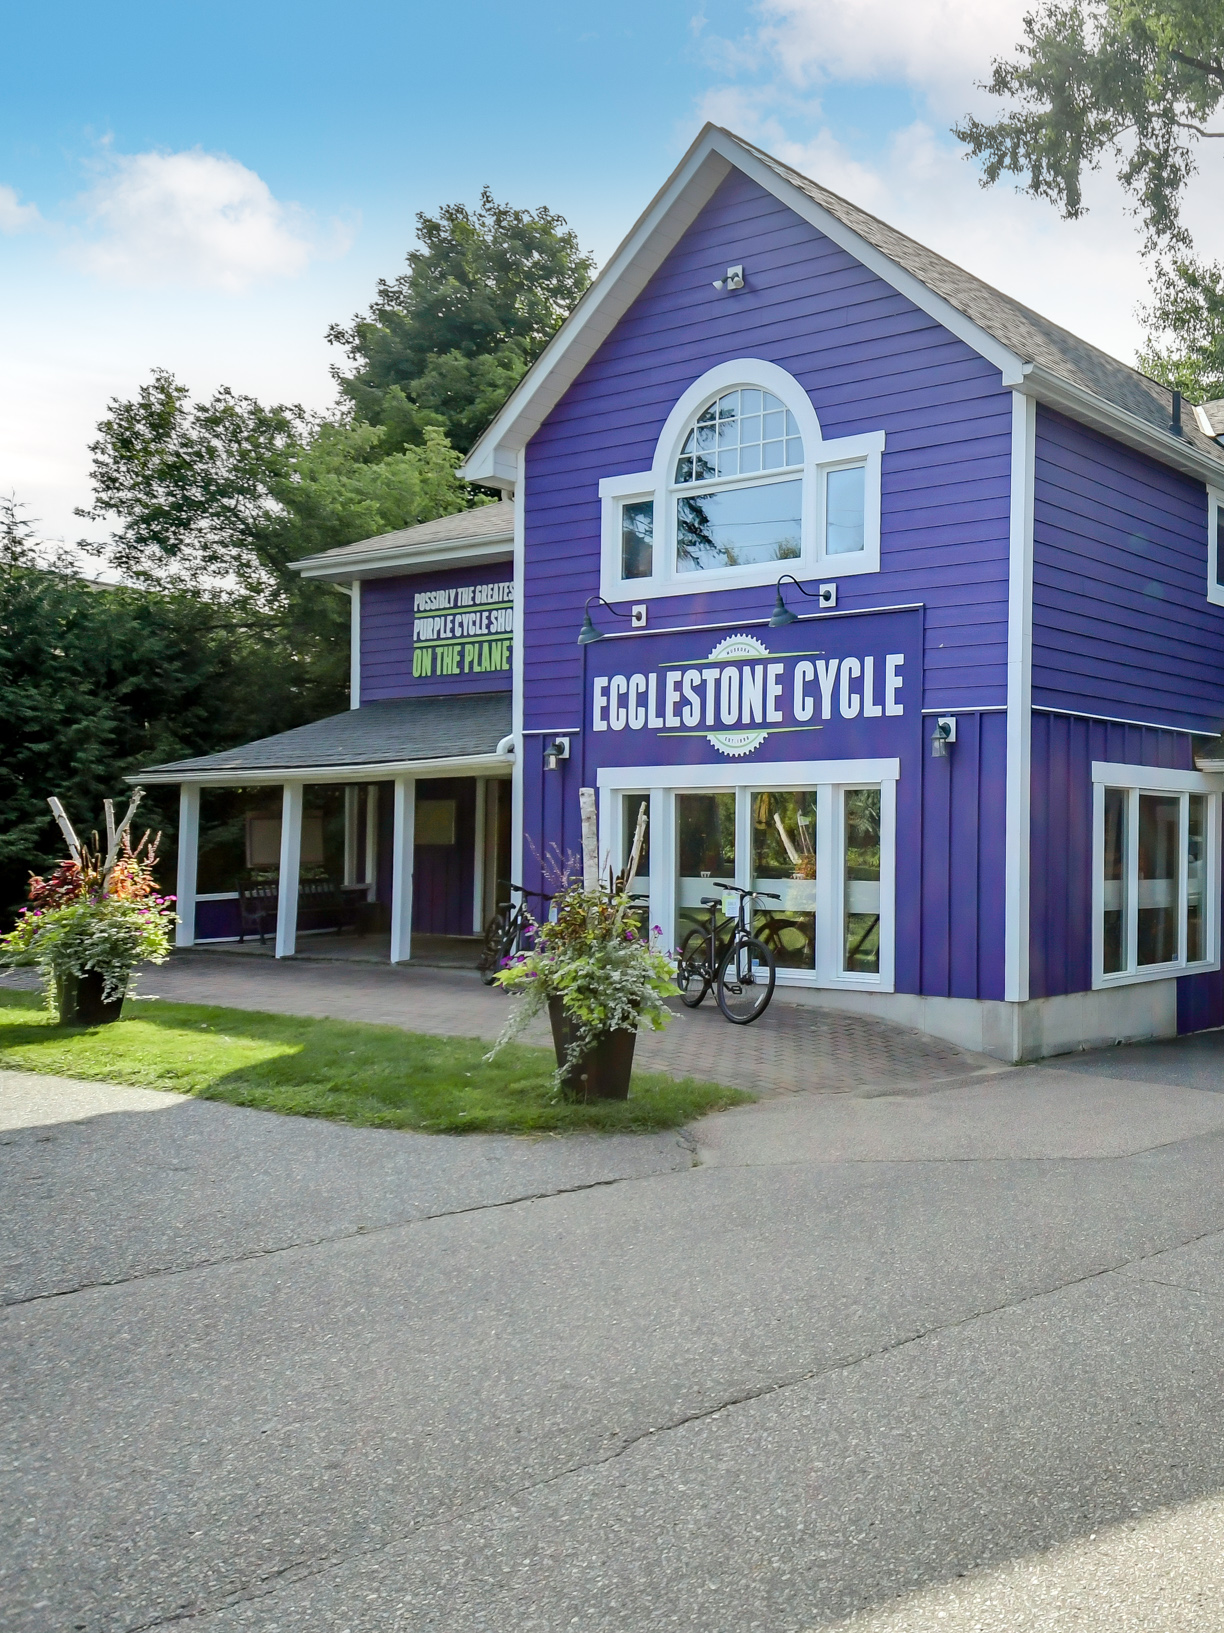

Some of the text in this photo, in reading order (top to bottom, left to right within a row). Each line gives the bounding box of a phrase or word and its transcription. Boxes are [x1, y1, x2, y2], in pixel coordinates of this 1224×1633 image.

[414, 581, 514, 612] POSSIBLY THE GREATES
[413, 608, 513, 641] PURPLE CYCLE SHO
[412, 640, 513, 678] ON THE PLANE
[592, 653, 905, 732] ECCLESTONE CYCLE
